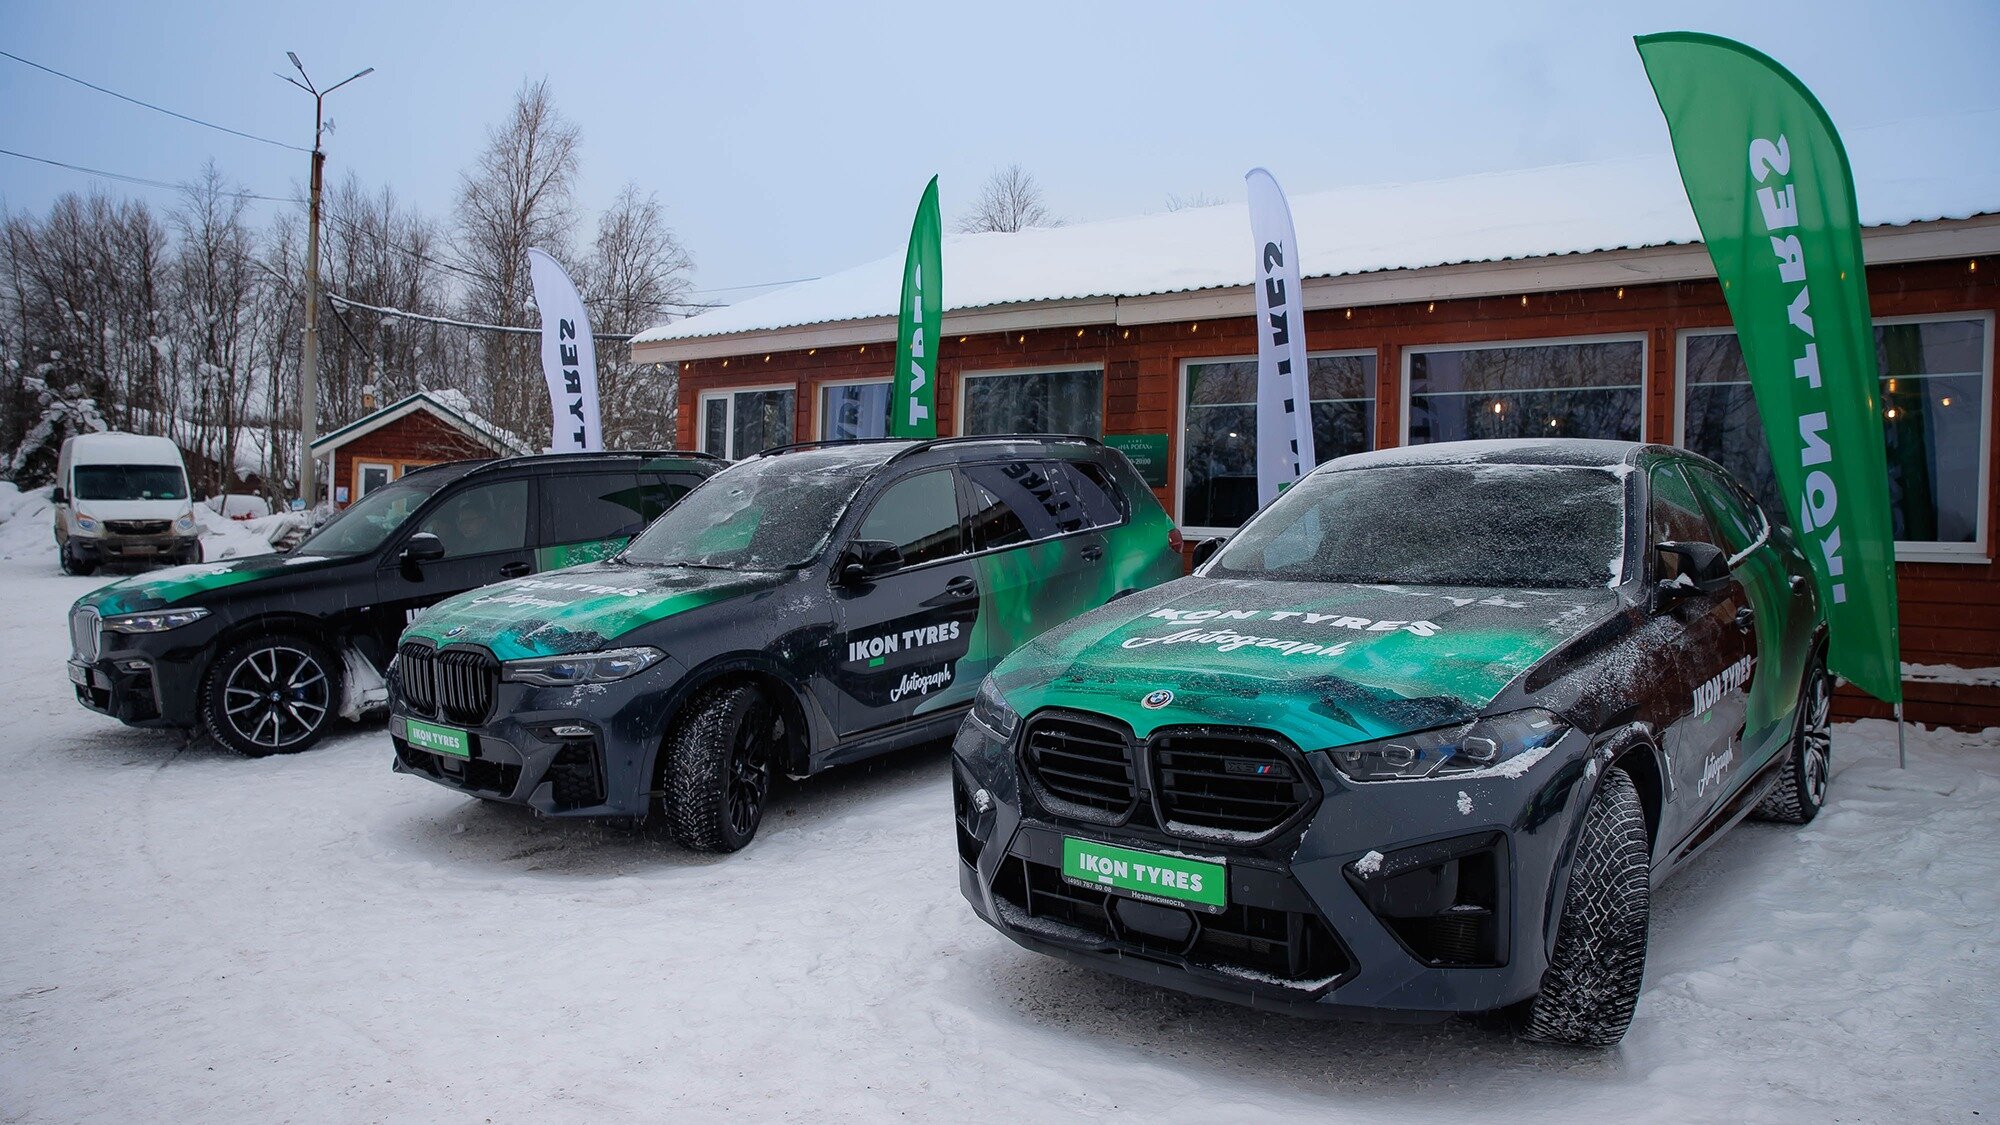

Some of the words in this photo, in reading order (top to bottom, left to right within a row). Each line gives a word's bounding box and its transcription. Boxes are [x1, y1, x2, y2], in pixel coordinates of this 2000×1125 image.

[848, 633, 899, 662] IKON
[902, 620, 960, 650] TYRES
[1121, 627, 1353, 657] Autograph
[1267, 610, 1443, 637] TYRES
[890, 663, 952, 702] Autograph
[1692, 676, 1721, 719] IKON
[1720, 653, 1752, 697] TYRES
[412, 728, 432, 743] IKON
[432, 732, 460, 749] TYRES
[1697, 736, 1734, 798] Autograph
[1079, 852, 1129, 879] IKON
[1132, 863, 1204, 893] TYRES
[1131, 890, 1186, 908] Независимость
